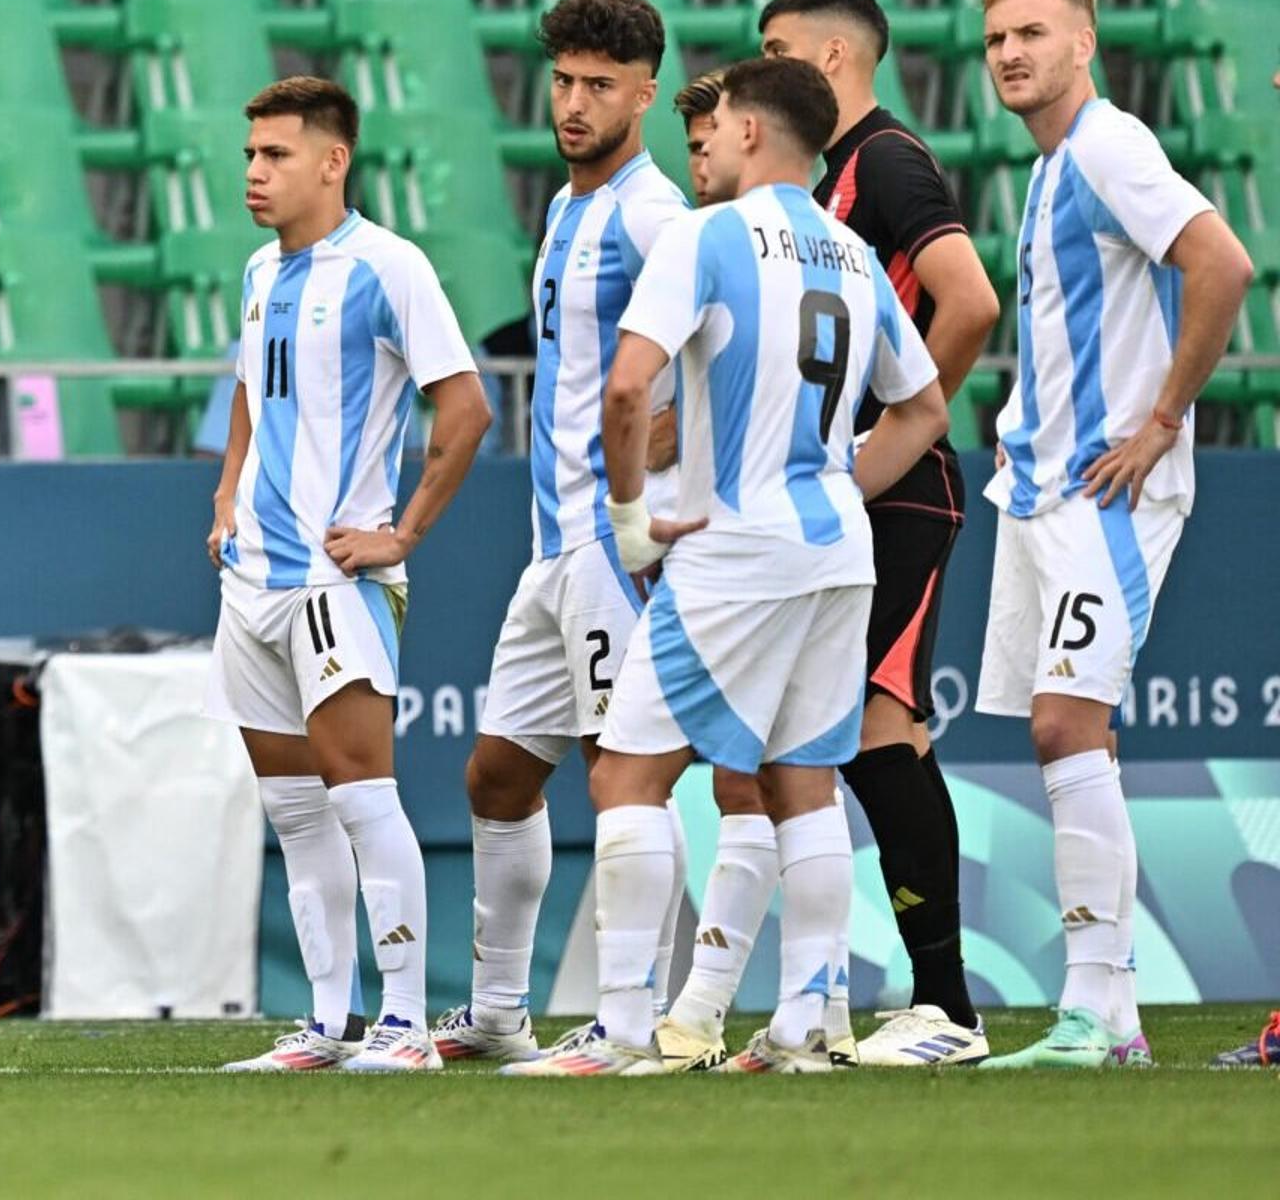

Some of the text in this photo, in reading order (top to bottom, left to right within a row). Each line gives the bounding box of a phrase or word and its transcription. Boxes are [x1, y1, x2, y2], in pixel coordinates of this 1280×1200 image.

[542, 278, 556, 340] 2
[266, 337, 288, 399] 11
[797, 289, 850, 446] 9
[306, 591, 336, 655] 11
[1049, 590, 1104, 651] 15
[585, 629, 613, 691] 2
